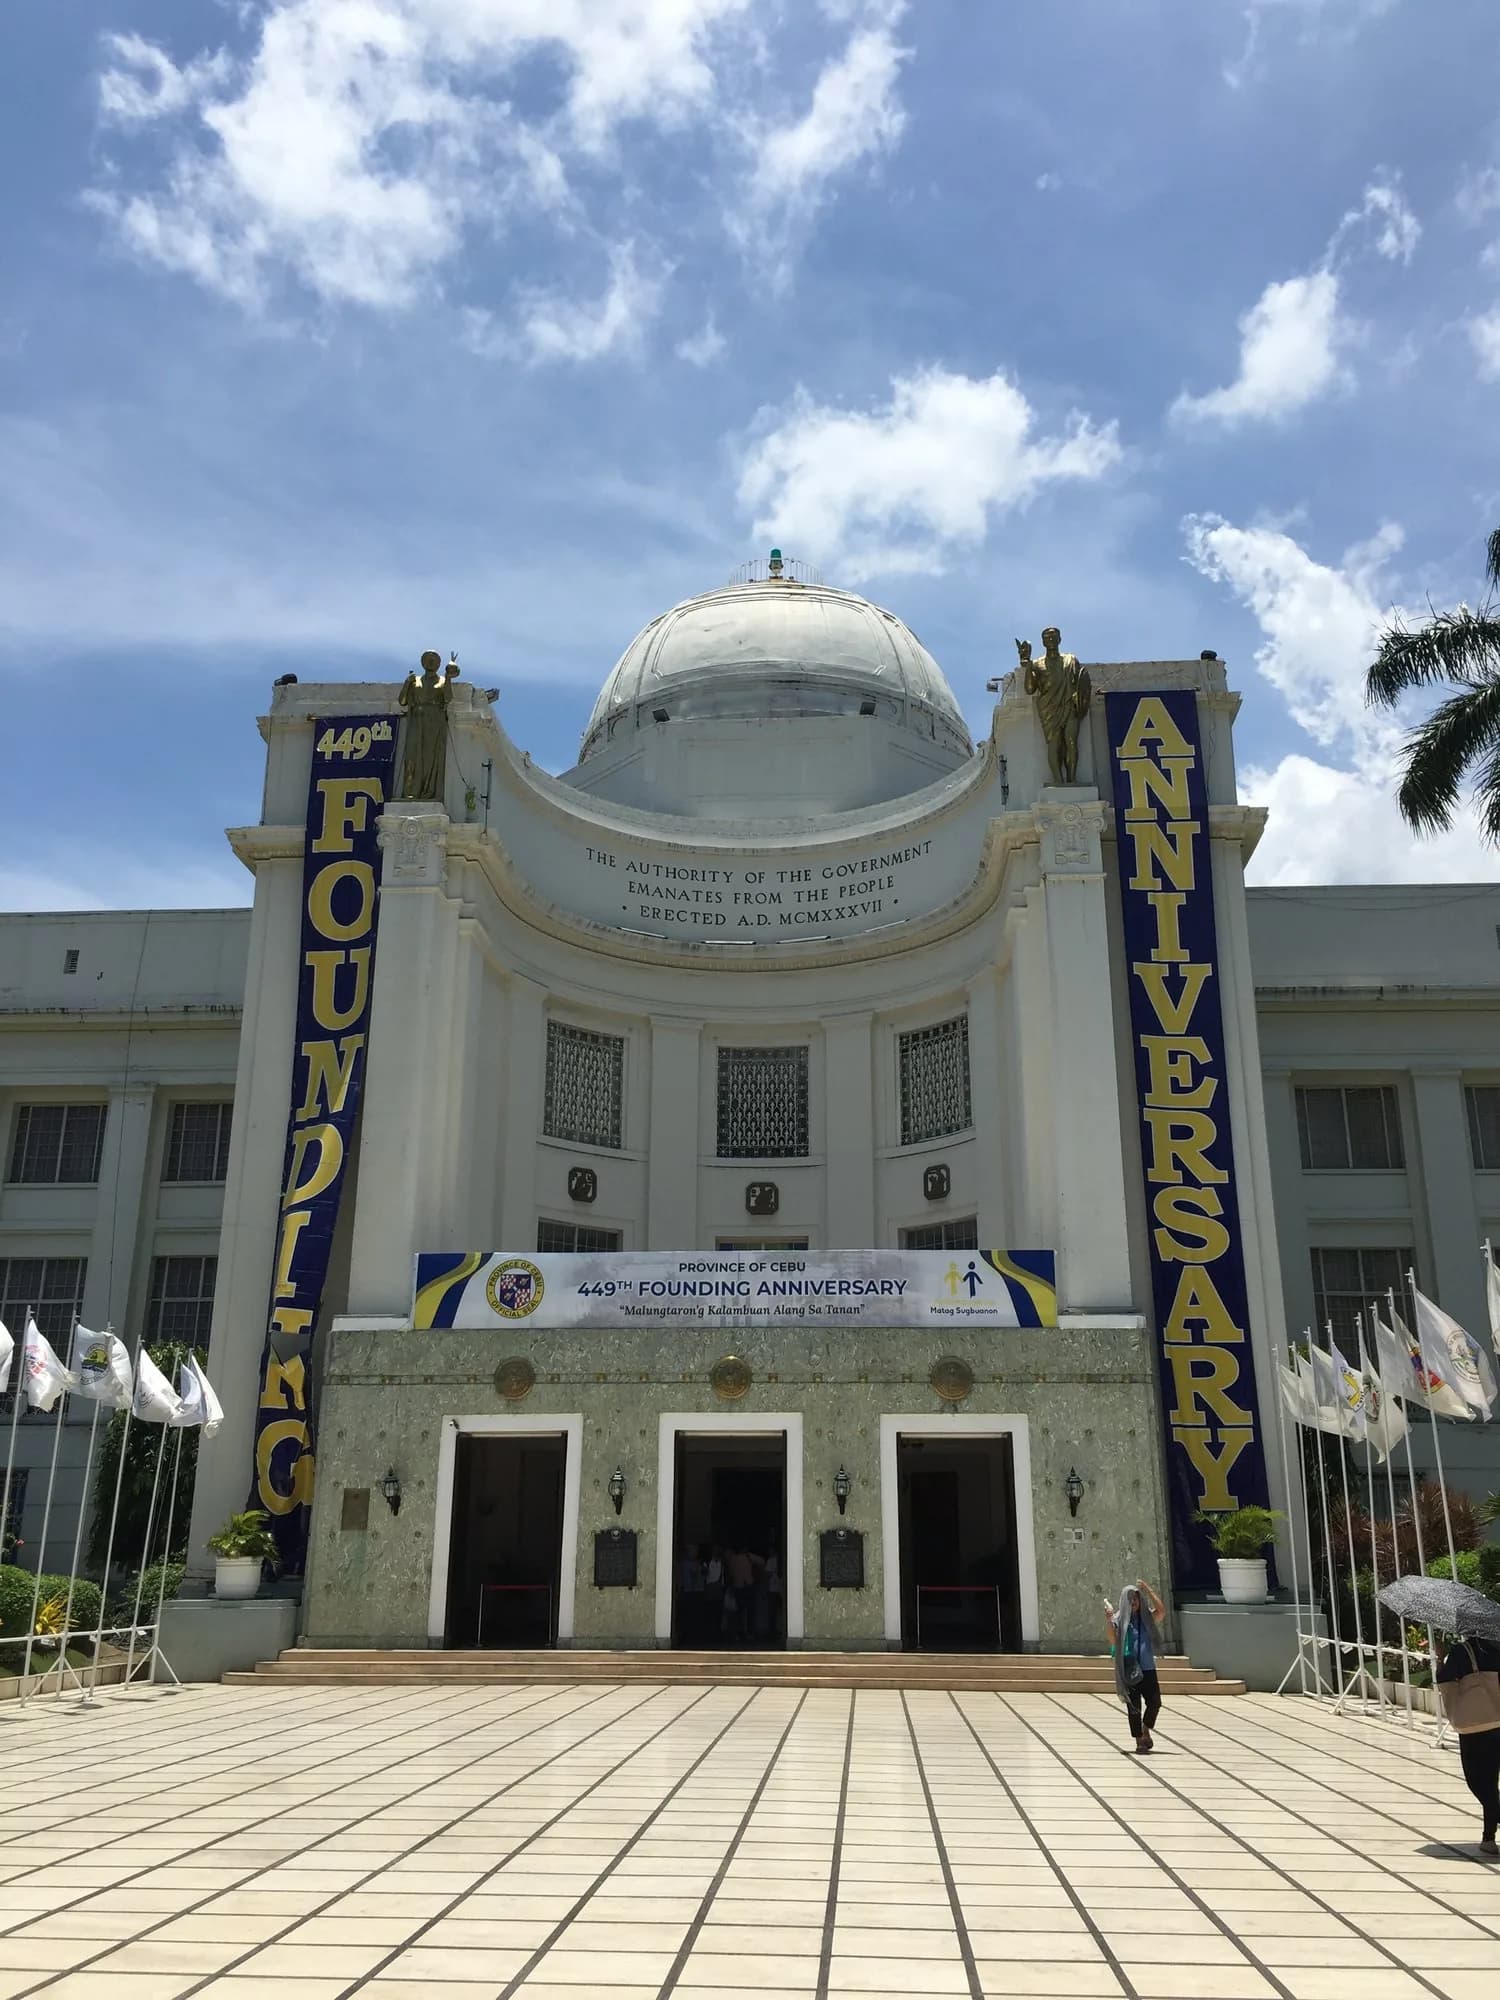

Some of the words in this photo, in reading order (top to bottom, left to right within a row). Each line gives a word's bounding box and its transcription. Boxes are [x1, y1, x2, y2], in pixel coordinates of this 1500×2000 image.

[317, 721, 393, 760] 449th
[585, 847, 617, 868] THE
[625, 861, 734, 884] AUTHORITY
[744, 871, 766, 884] OF
[776, 869, 812, 884] THE
[822, 840, 933, 880] GOVERNMENT
[628, 881, 723, 904] EMANATES
[733, 892, 783, 905] FROM
[793, 888, 829, 903] THE
[839, 875, 895, 899] PEOPLE
[640, 905, 727, 926] ERECTED
[736, 914, 772, 927] A.D.
[779, 899, 883, 926] MCMXXXVII
[1116, 697, 1254, 1511] ANNIVERSARY
[679, 1262, 746, 1273] PROVINCE
[749, 1262, 767, 1272] OF
[770, 1262, 806, 1272] CEBU
[577, 1280, 633, 1297] 449TH
[638, 1281, 751, 1297] FOUNDING
[756, 1280, 908, 1296] ANNIVERSARY
[708, 1305, 771, 1316] Kalambuan
[773, 1304, 806, 1317] Alang
[808, 1304, 823, 1315] Sa
[930, 1306, 955, 1316] Matag
